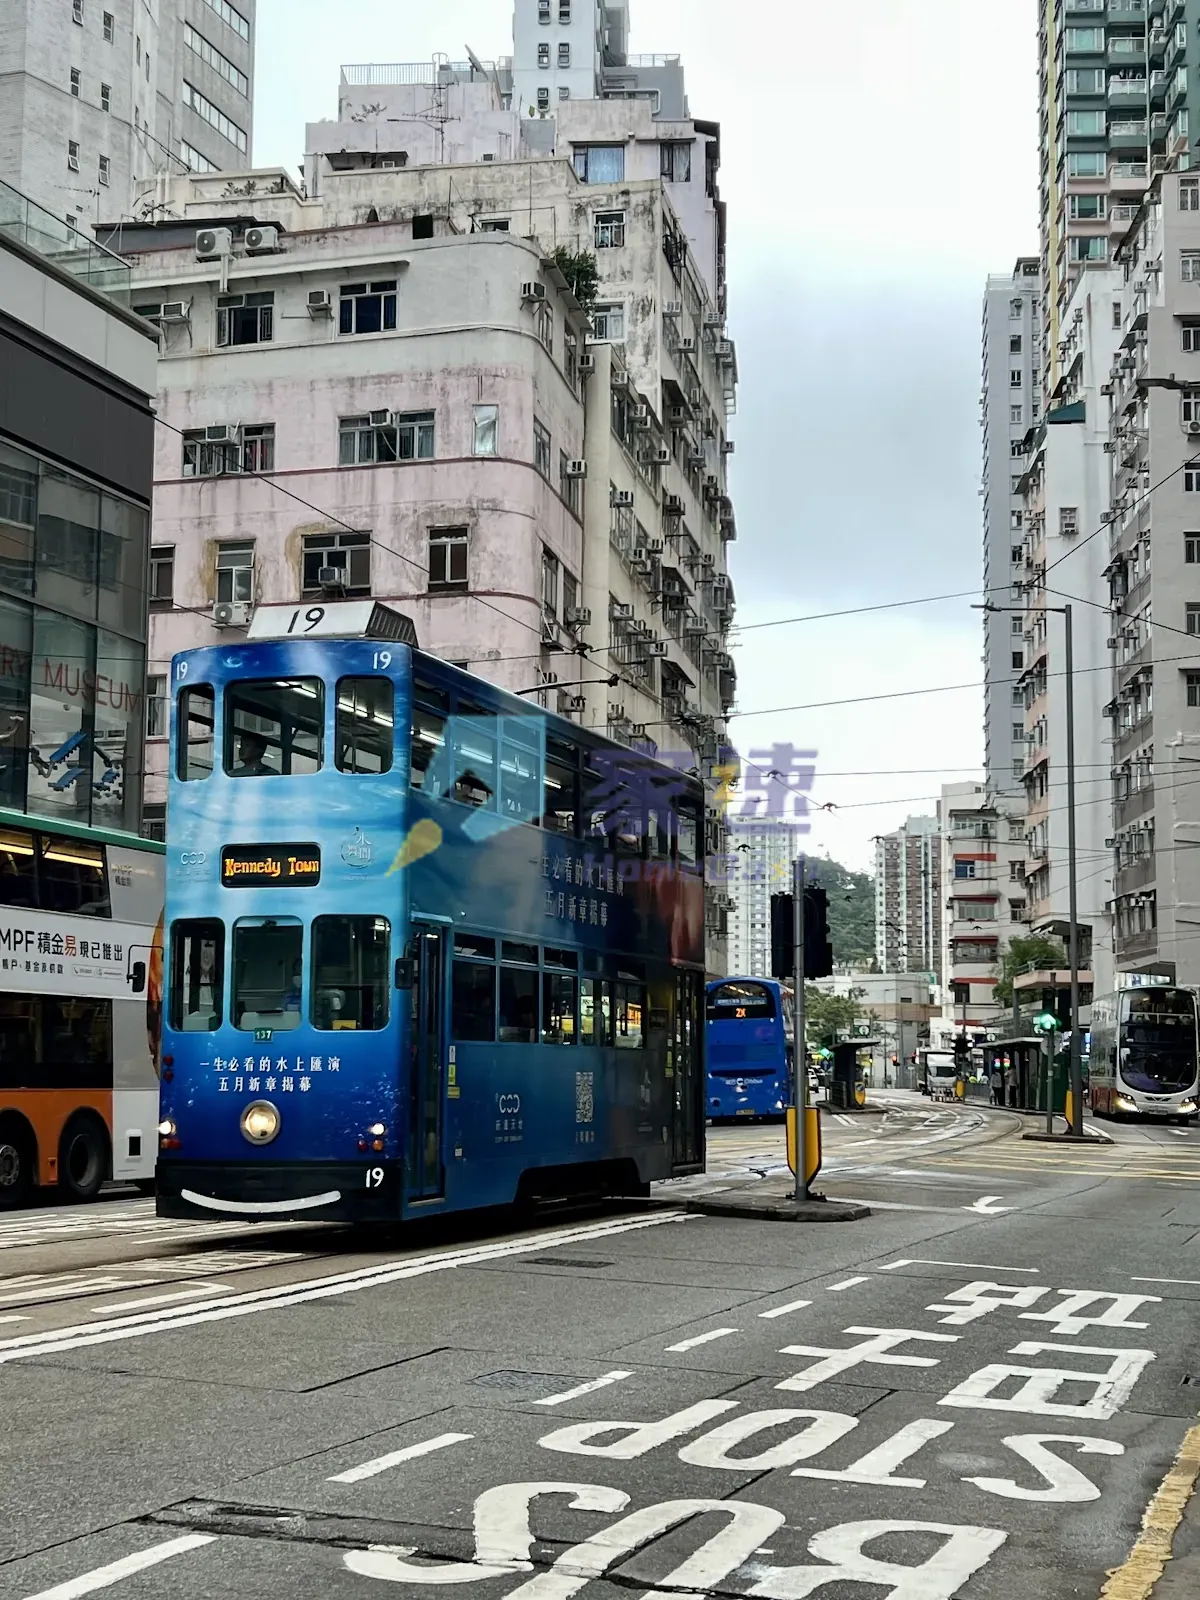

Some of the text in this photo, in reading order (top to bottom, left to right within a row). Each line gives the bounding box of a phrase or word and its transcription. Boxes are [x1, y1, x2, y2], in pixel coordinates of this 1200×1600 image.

[286, 606, 325, 634] 19
[176, 661, 188, 681] 19
[372, 651, 392, 670] 19
[44, 657, 141, 712] MUSEUM
[224, 857, 281, 877] Kennedy
[287, 857, 319, 876] Town
[544, 889, 609, 927] 五月新章揭幕
[80, 940, 123, 962] 現已推出
[735, 1008, 747, 1018] 2X
[256, 1030, 272, 1040] 137
[200, 1056, 341, 1073] 一生必看的水上匯演
[218, 1076, 312, 1093] 五月新章揭幕
[365, 1167, 385, 1188] 19
[925, 1281, 1163, 1335] 站
[773, 1326, 1158, 1420] 巴士
[538, 1399, 1125, 1502] STOP
[343, 1481, 1009, 1600] BUS
